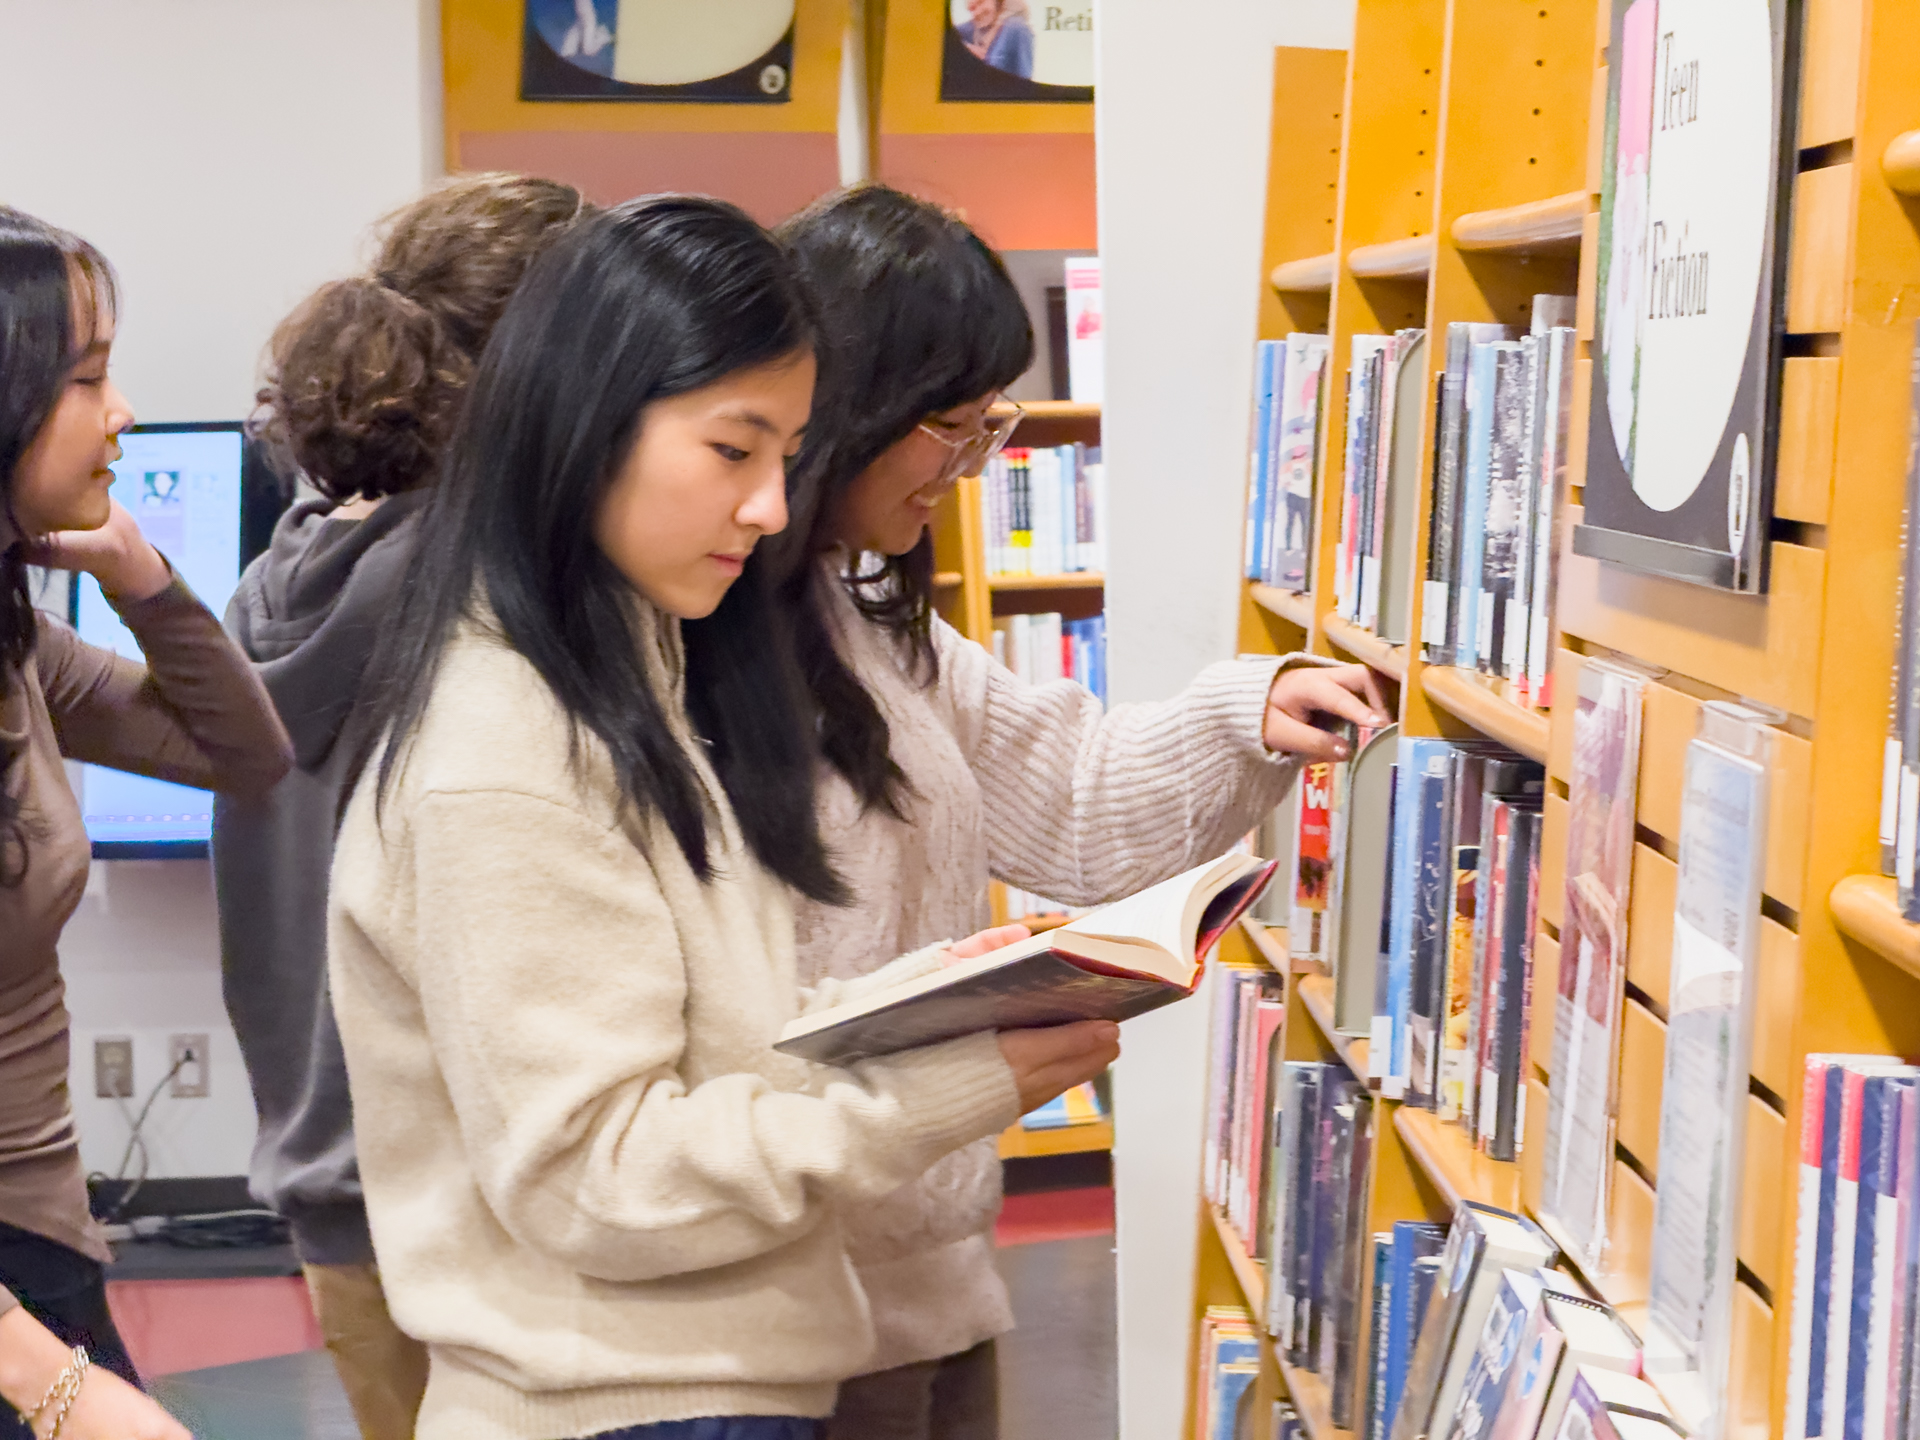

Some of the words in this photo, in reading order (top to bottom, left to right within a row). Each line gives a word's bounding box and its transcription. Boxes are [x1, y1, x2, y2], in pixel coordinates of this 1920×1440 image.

[1044, 6, 1093, 31] Reti
[1661, 31, 1698, 131] Teen
[1649, 220, 1708, 319] Fiction
